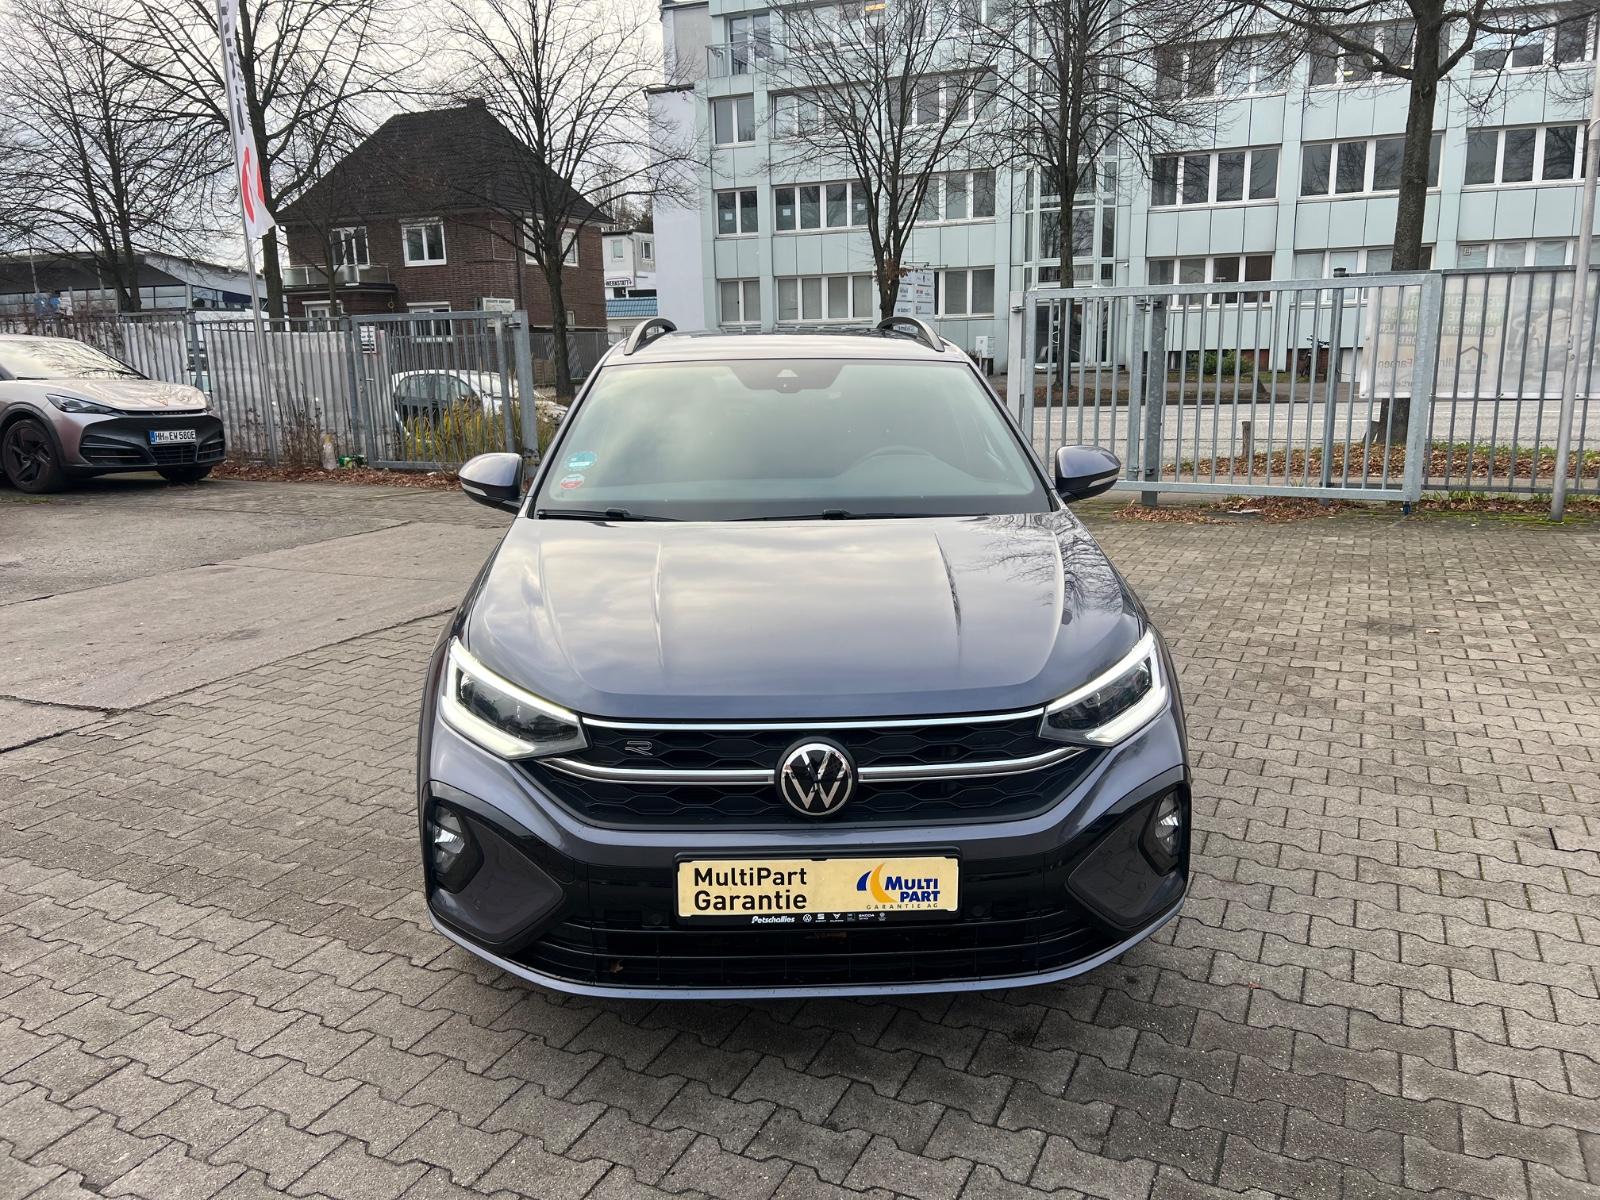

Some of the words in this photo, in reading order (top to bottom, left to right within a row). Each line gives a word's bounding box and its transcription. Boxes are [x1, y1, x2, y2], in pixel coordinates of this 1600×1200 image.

[694, 867, 807, 887] MultiPart
[694, 889, 808, 911] Garantie
[899, 890, 941, 903] PART
